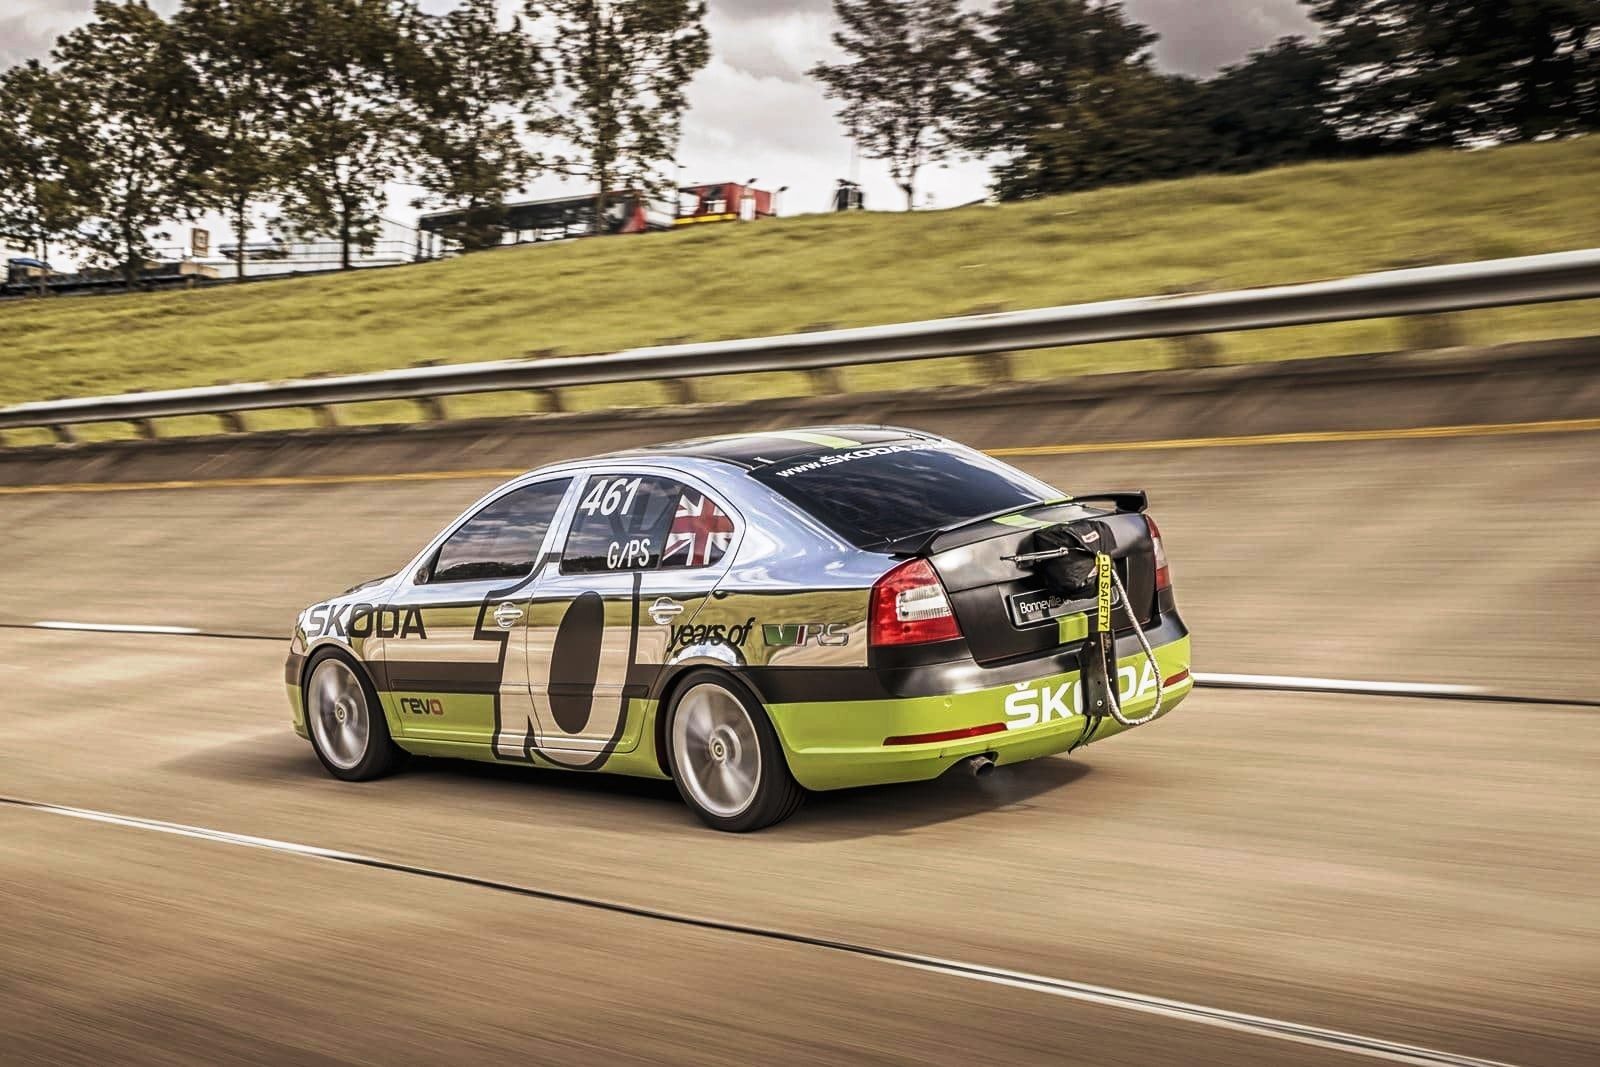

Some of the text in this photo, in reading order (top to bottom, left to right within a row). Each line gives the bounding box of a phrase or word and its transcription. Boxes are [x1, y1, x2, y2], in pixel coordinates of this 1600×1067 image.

[580, 477, 642, 516] 461
[607, 538, 650, 569] G/PS
[1019, 595, 1061, 614] Bonneville
[1099, 564, 1109, 628] DJ SAFETY
[667, 624, 726, 652] years
[728, 617, 755, 646] of
[473, 552, 642, 771] 10
[400, 697, 443, 715] revo
